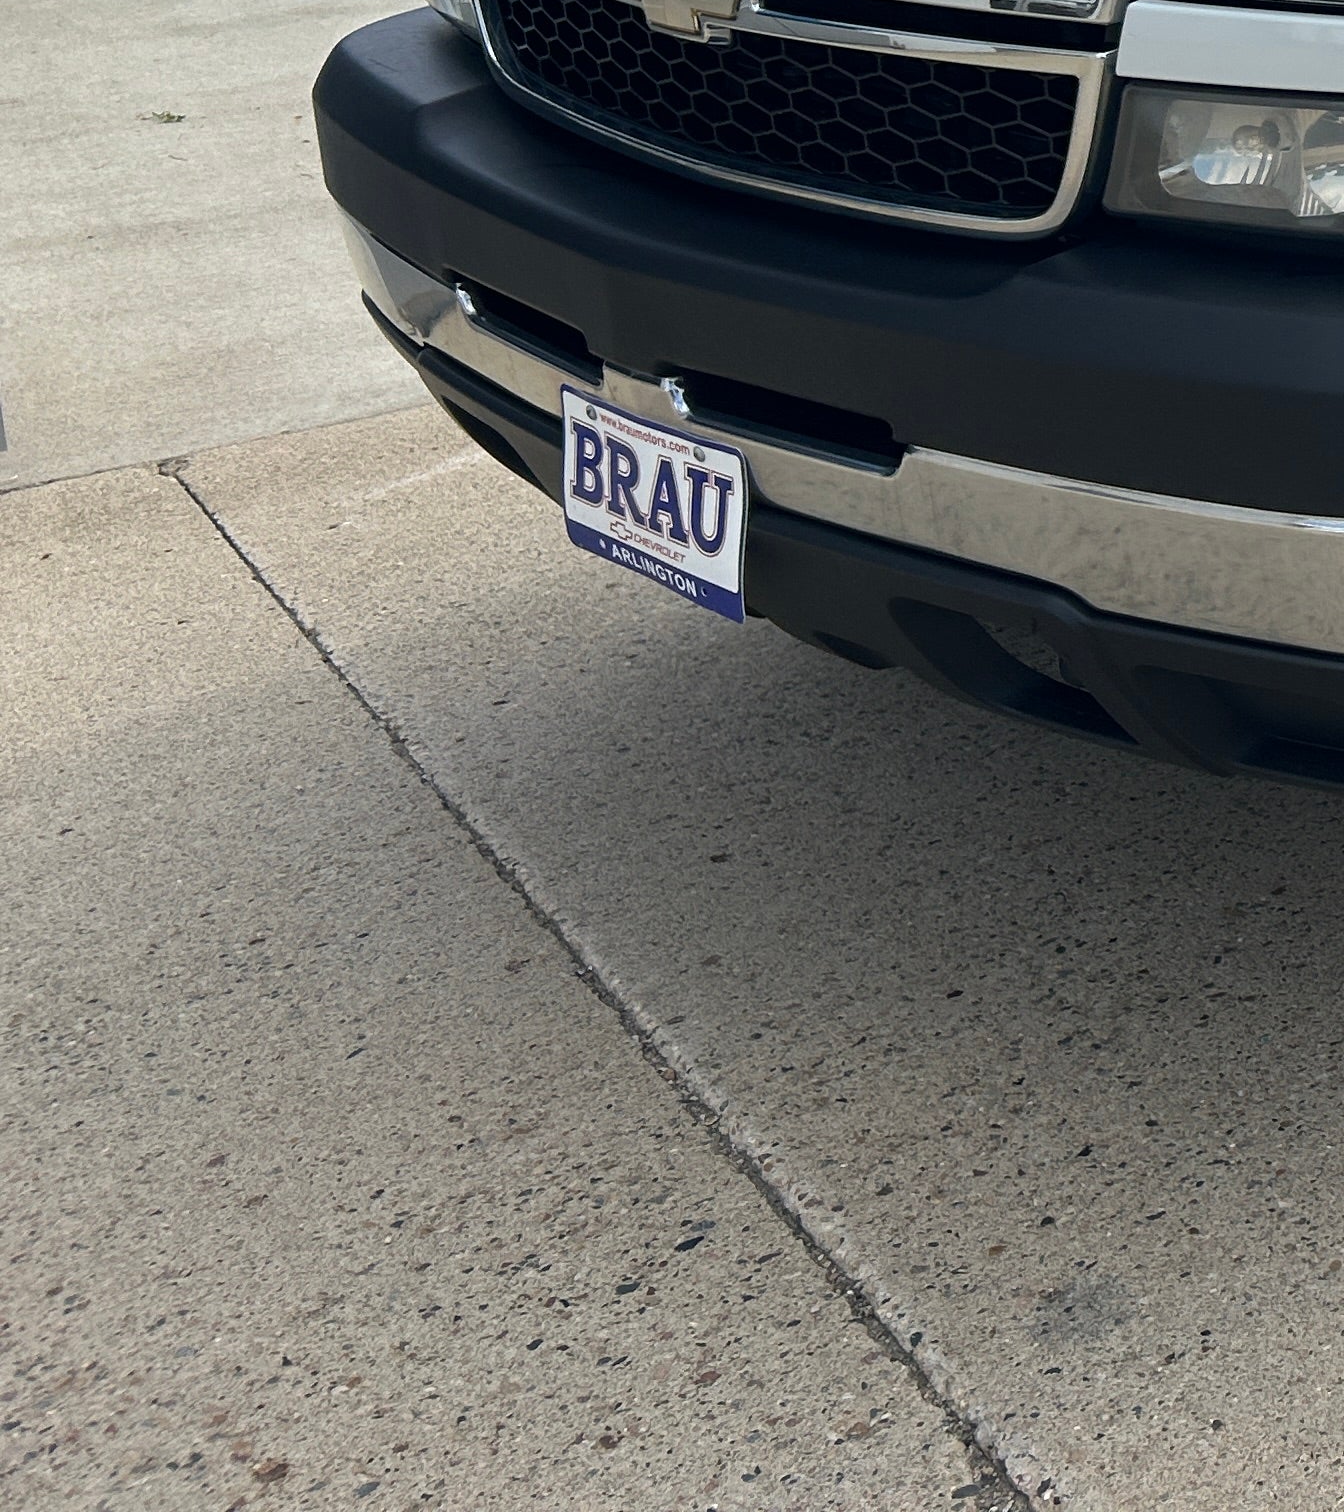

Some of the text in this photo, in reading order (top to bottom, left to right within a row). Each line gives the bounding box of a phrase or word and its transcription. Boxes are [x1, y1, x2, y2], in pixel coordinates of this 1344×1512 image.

[600, 413, 690, 456] www.braumotors.com
[570, 416, 734, 557] BRAU
[612, 544, 697, 597] ARLINGTON
[633, 533, 686, 563] CHEVROLET
